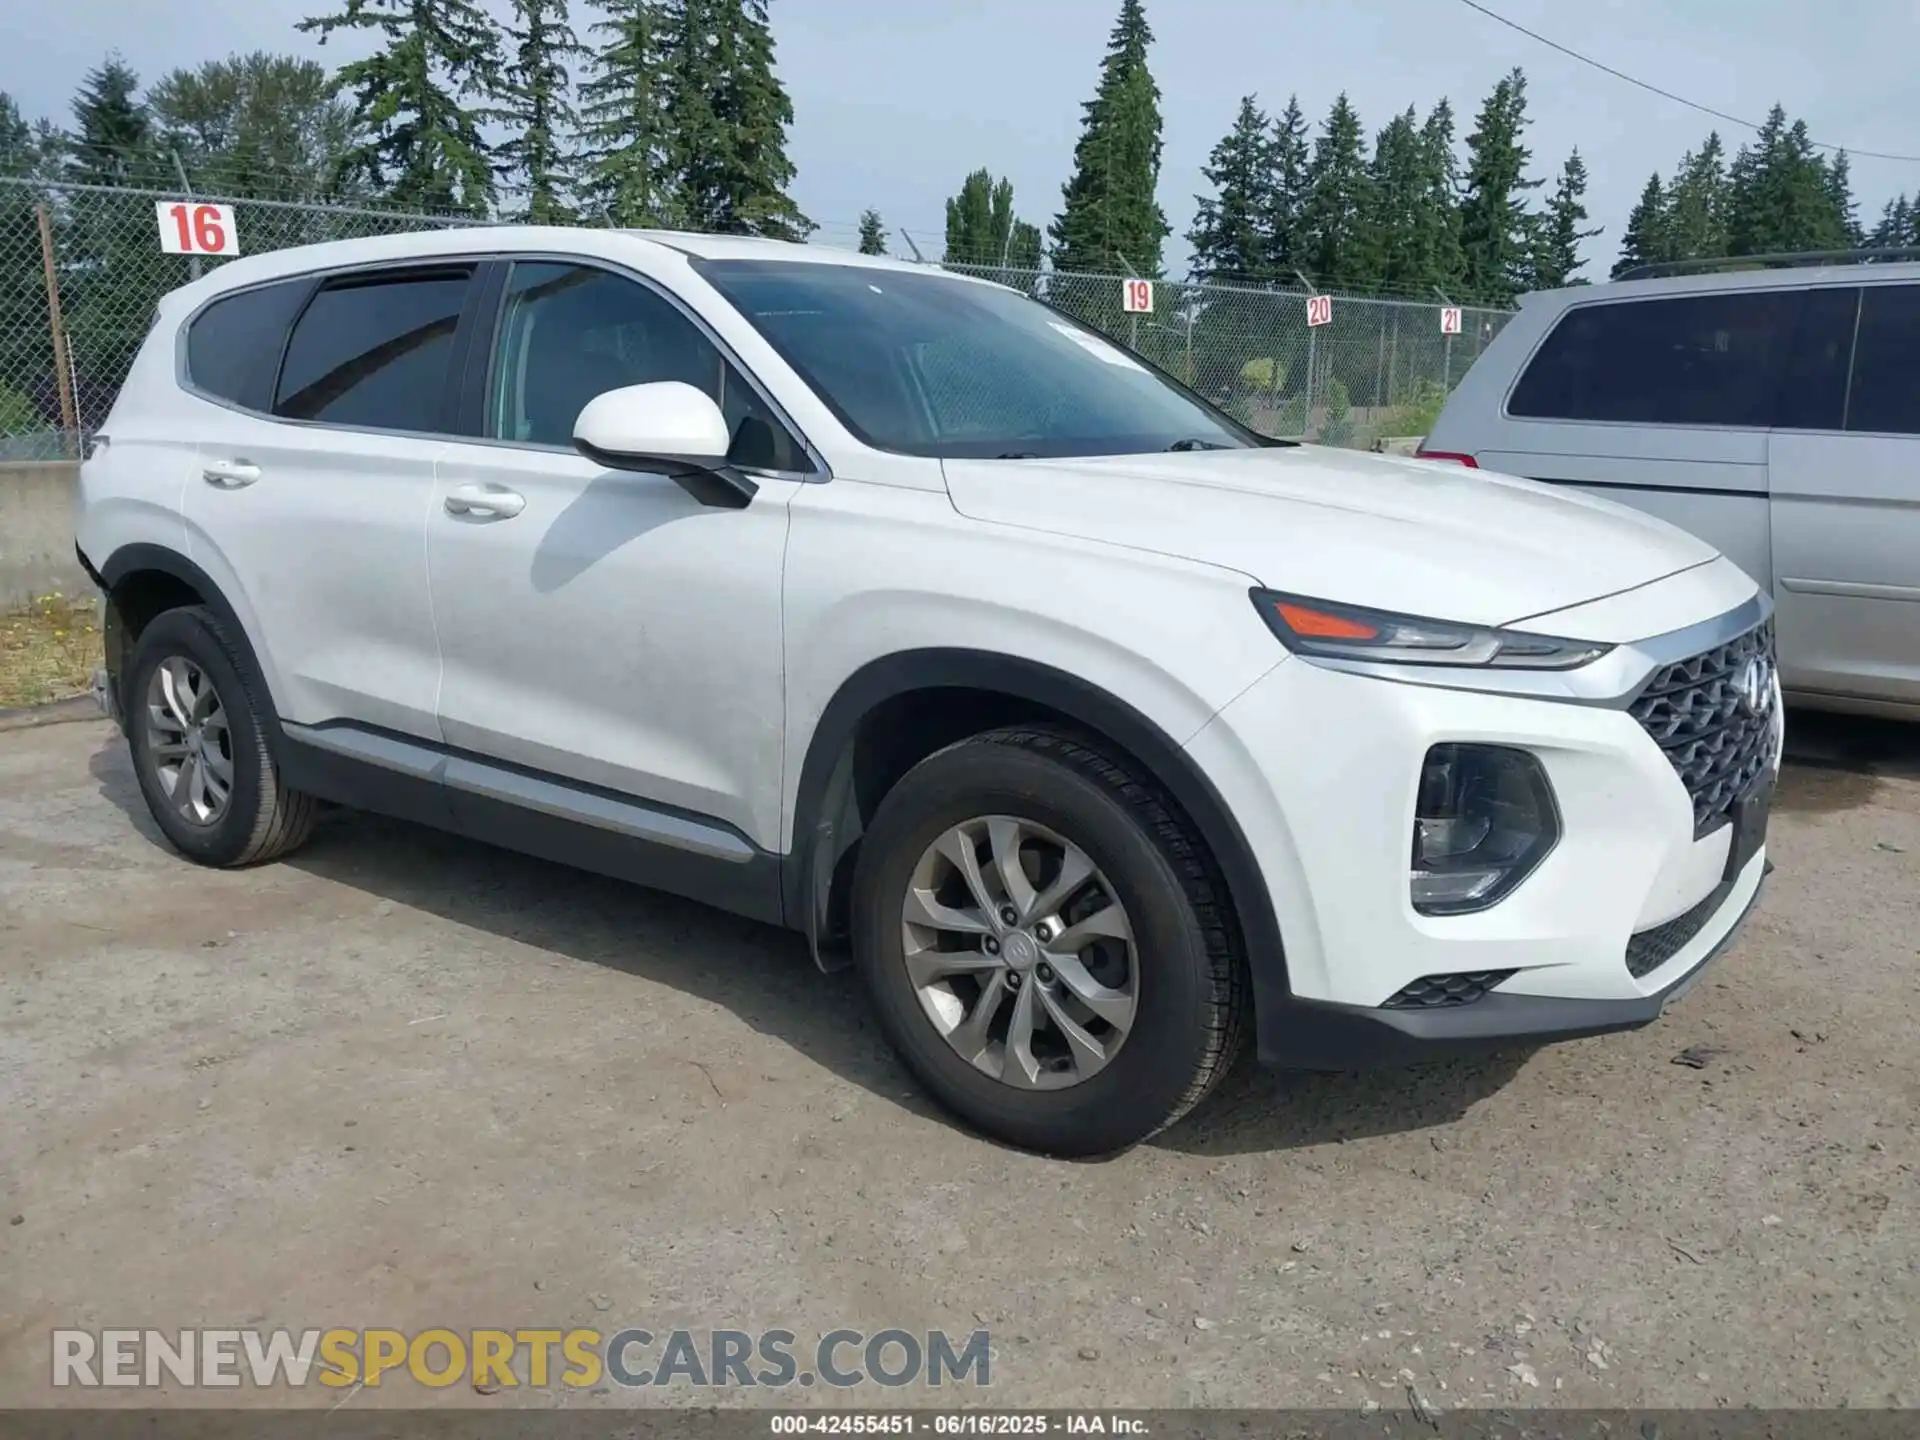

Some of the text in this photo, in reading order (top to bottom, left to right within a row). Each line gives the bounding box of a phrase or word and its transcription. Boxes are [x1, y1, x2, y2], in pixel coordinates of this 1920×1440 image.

[170, 204, 225, 252] 16
[1127, 282, 1149, 310] 19
[1308, 299, 1330, 324] 20
[1443, 310, 1459, 331] 21
